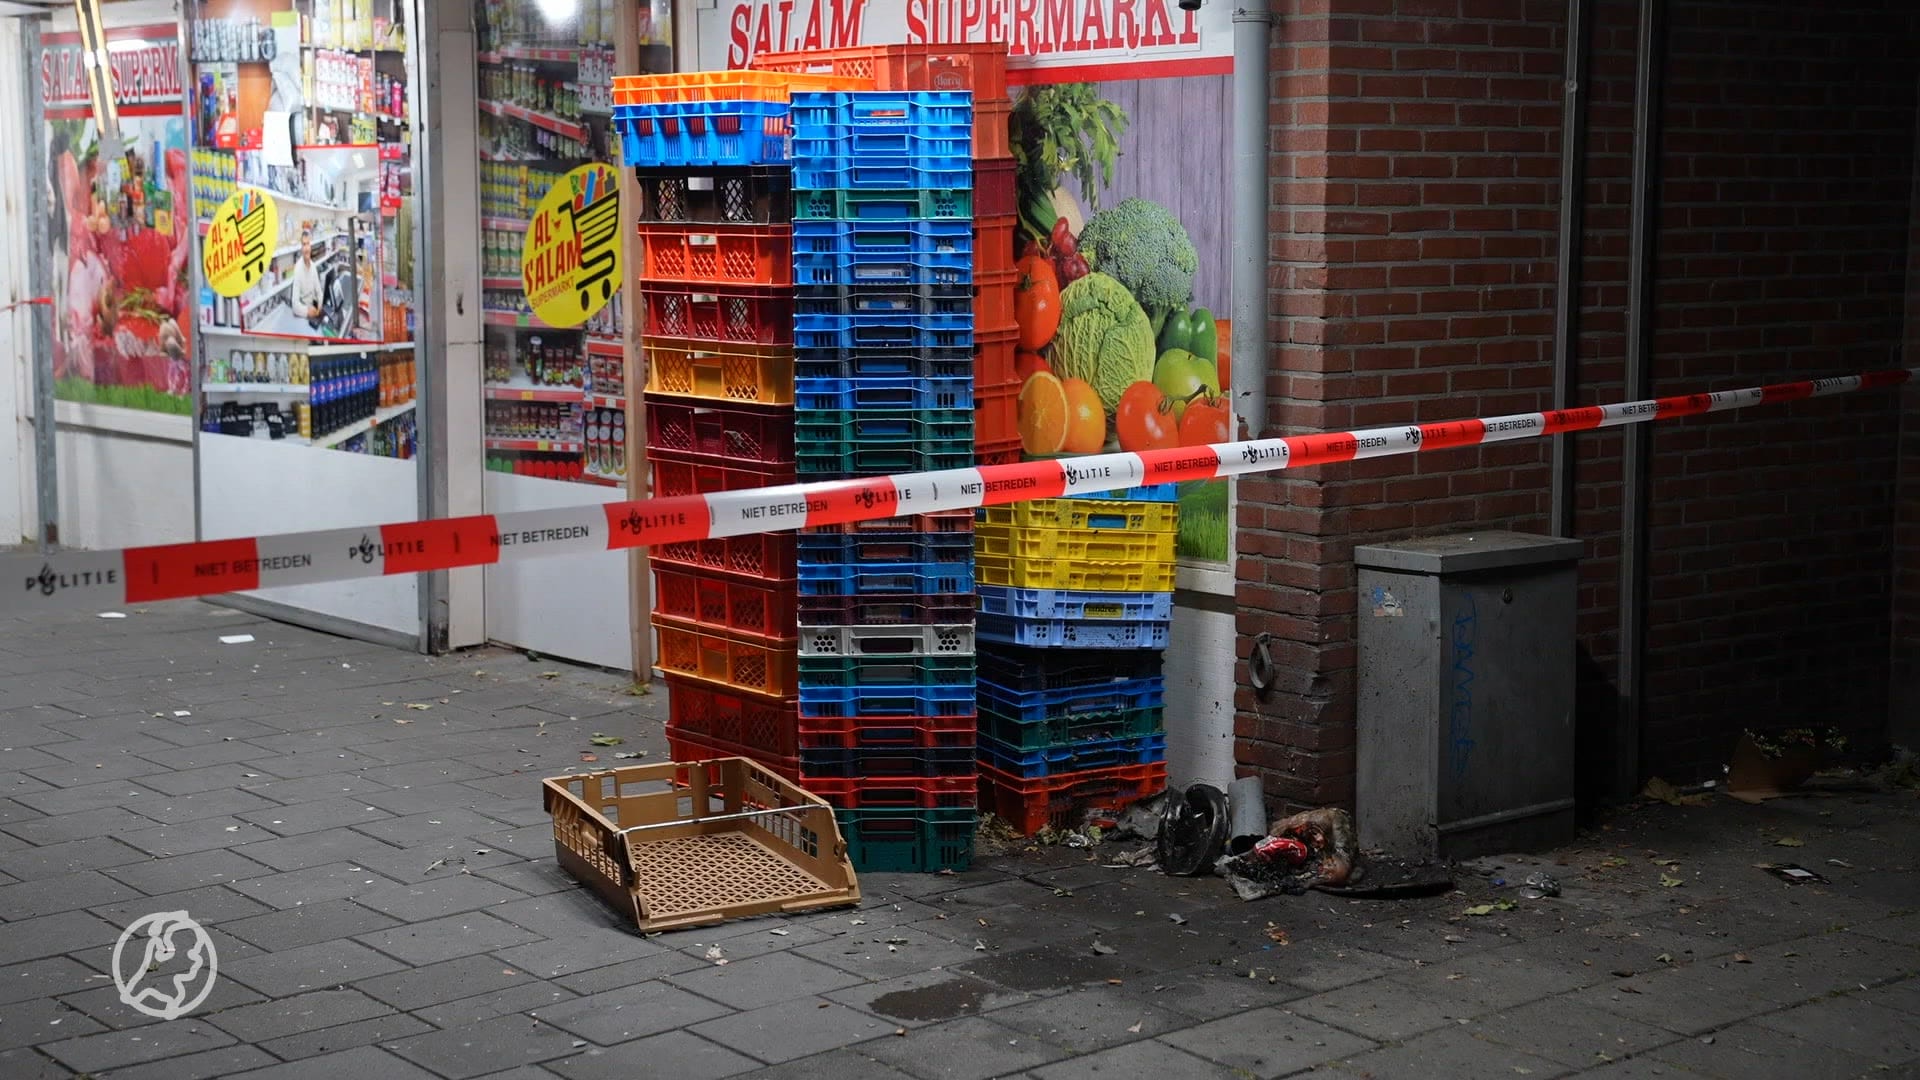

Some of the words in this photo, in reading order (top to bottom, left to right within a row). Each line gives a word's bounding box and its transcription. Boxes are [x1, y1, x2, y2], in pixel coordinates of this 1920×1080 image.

[728, 0, 865, 70] SALAM
[42, 52, 89, 101] SALA
[206, 233, 244, 278] SALAM
[524, 231, 583, 296] SALAM
[25, 563, 118, 596] POLITIE
[195, 562, 227, 577] NIET
[233, 554, 312, 574] BETREDEN
[349, 533, 425, 564] POLITIE
[490, 533, 518, 547] NIET
[522, 525, 589, 544] BETREDEN
[620, 508, 686, 535] POLITIE
[742, 506, 767, 519] NIET
[770, 500, 828, 516] BETREDEN
[855, 487, 912, 509] POLITIE
[961, 483, 982, 495] NIET
[985, 477, 1036, 492] BETREDEN
[1060, 464, 1111, 486] POLITIE
[1154, 459, 1174, 473] NIET
[1176, 455, 1221, 470] BETREDEN
[1242, 444, 1288, 464] POLITIE
[1326, 441, 1344, 452] NIET
[1345, 436, 1387, 450] BETREDEN
[1499, 418, 1537, 432] BETREDEN
[1622, 405, 1637, 416] NIET
[1639, 401, 1672, 414] BETRE
